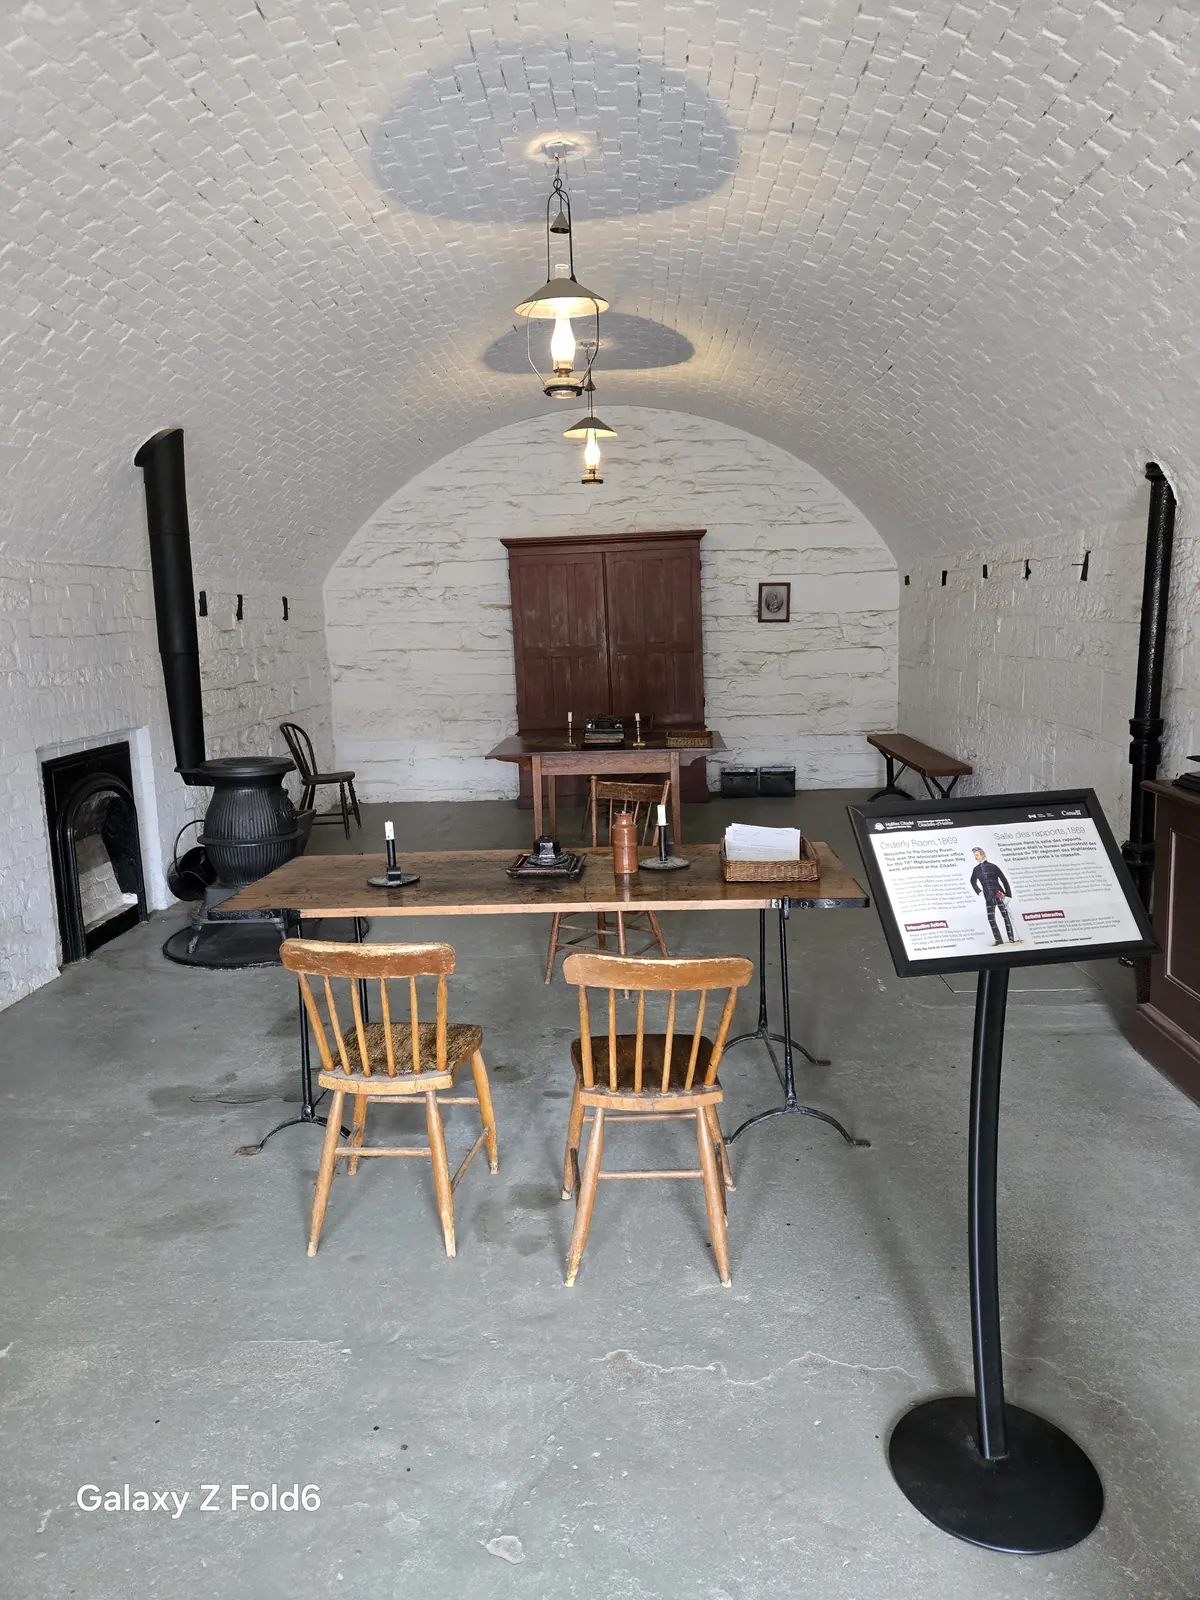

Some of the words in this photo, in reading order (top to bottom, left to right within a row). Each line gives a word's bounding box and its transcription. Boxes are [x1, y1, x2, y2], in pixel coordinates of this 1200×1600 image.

[994, 832, 1014, 840] Salle
[1016, 830, 1030, 839] des
[880, 840, 909, 849] Orderly
